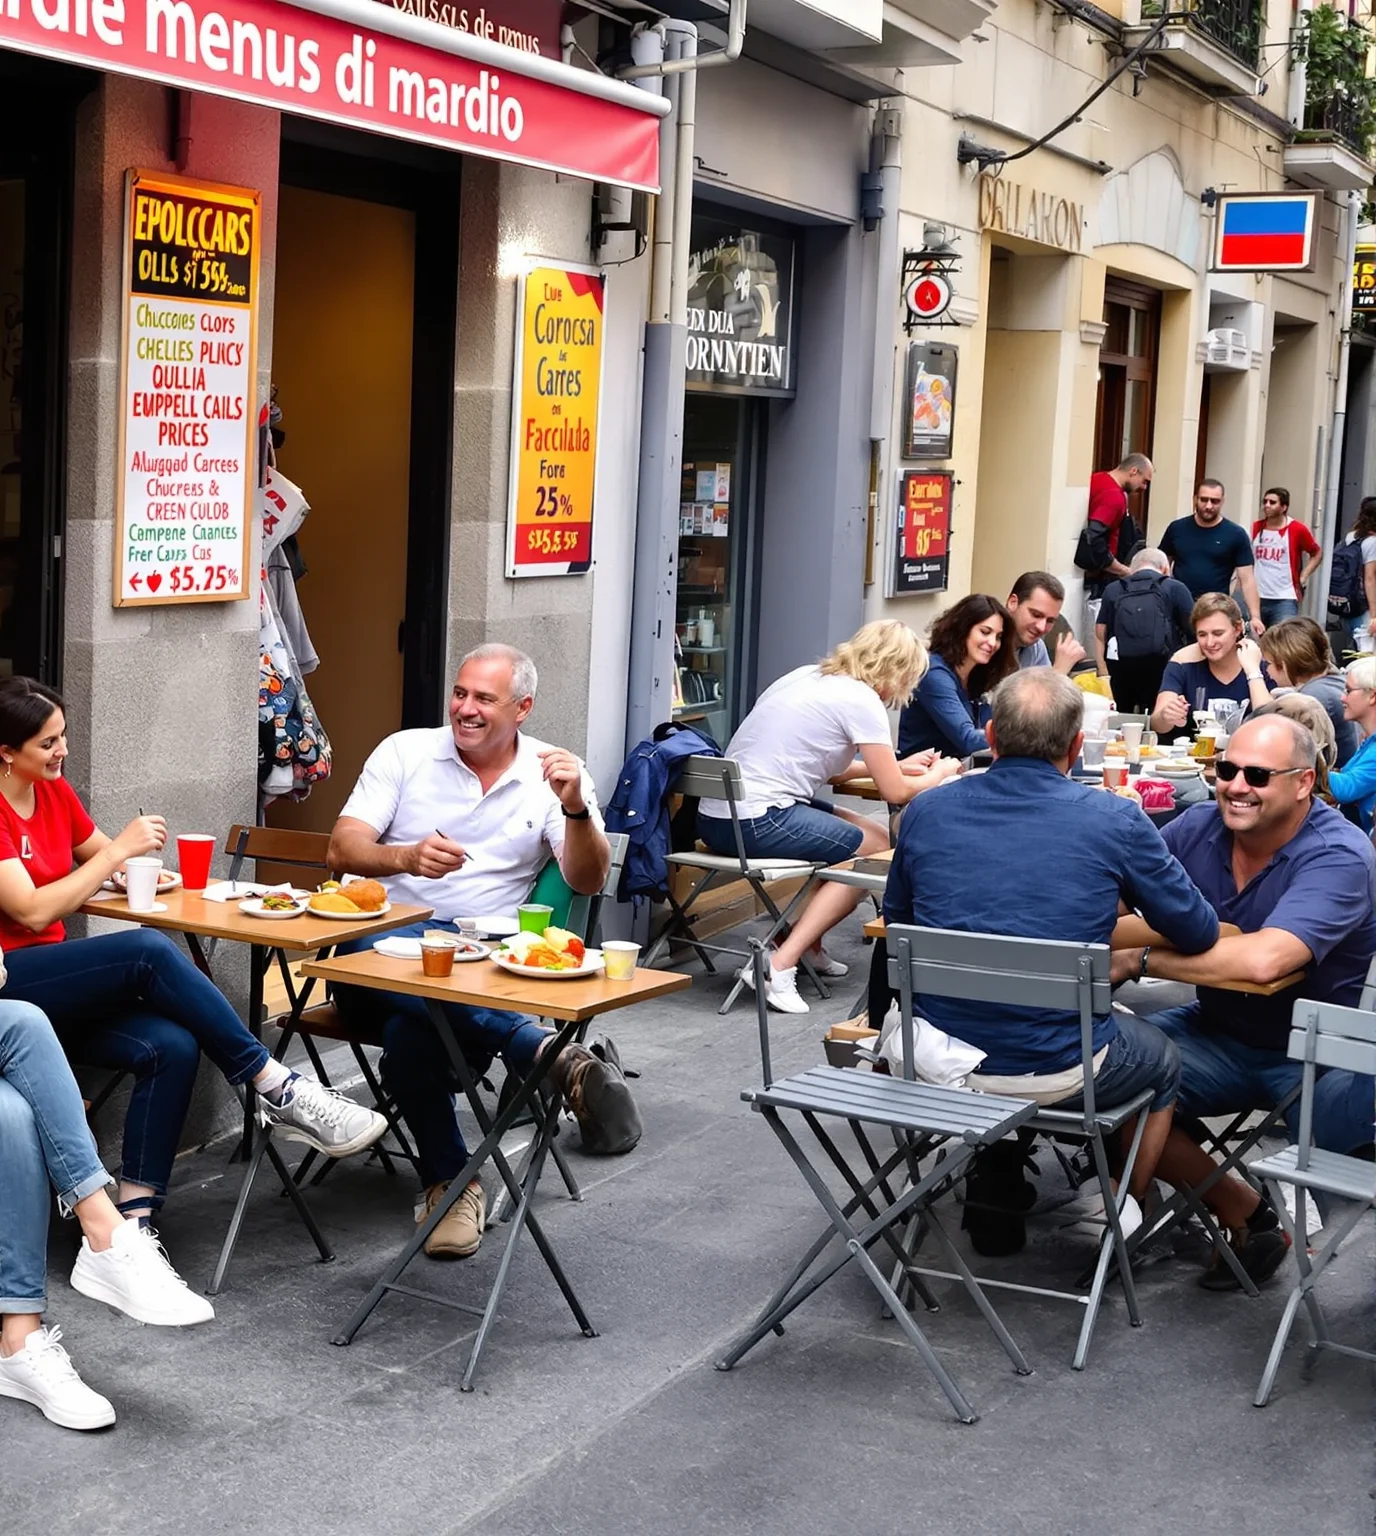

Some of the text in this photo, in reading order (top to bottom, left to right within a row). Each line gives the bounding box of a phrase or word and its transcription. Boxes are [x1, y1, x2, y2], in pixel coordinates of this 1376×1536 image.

[146, 0, 321, 94] menus
[335, 34, 376, 107] di
[388, 66, 524, 142] mardio
[159, 422, 208, 447] PRICES
[209, 479, 220, 496] &
